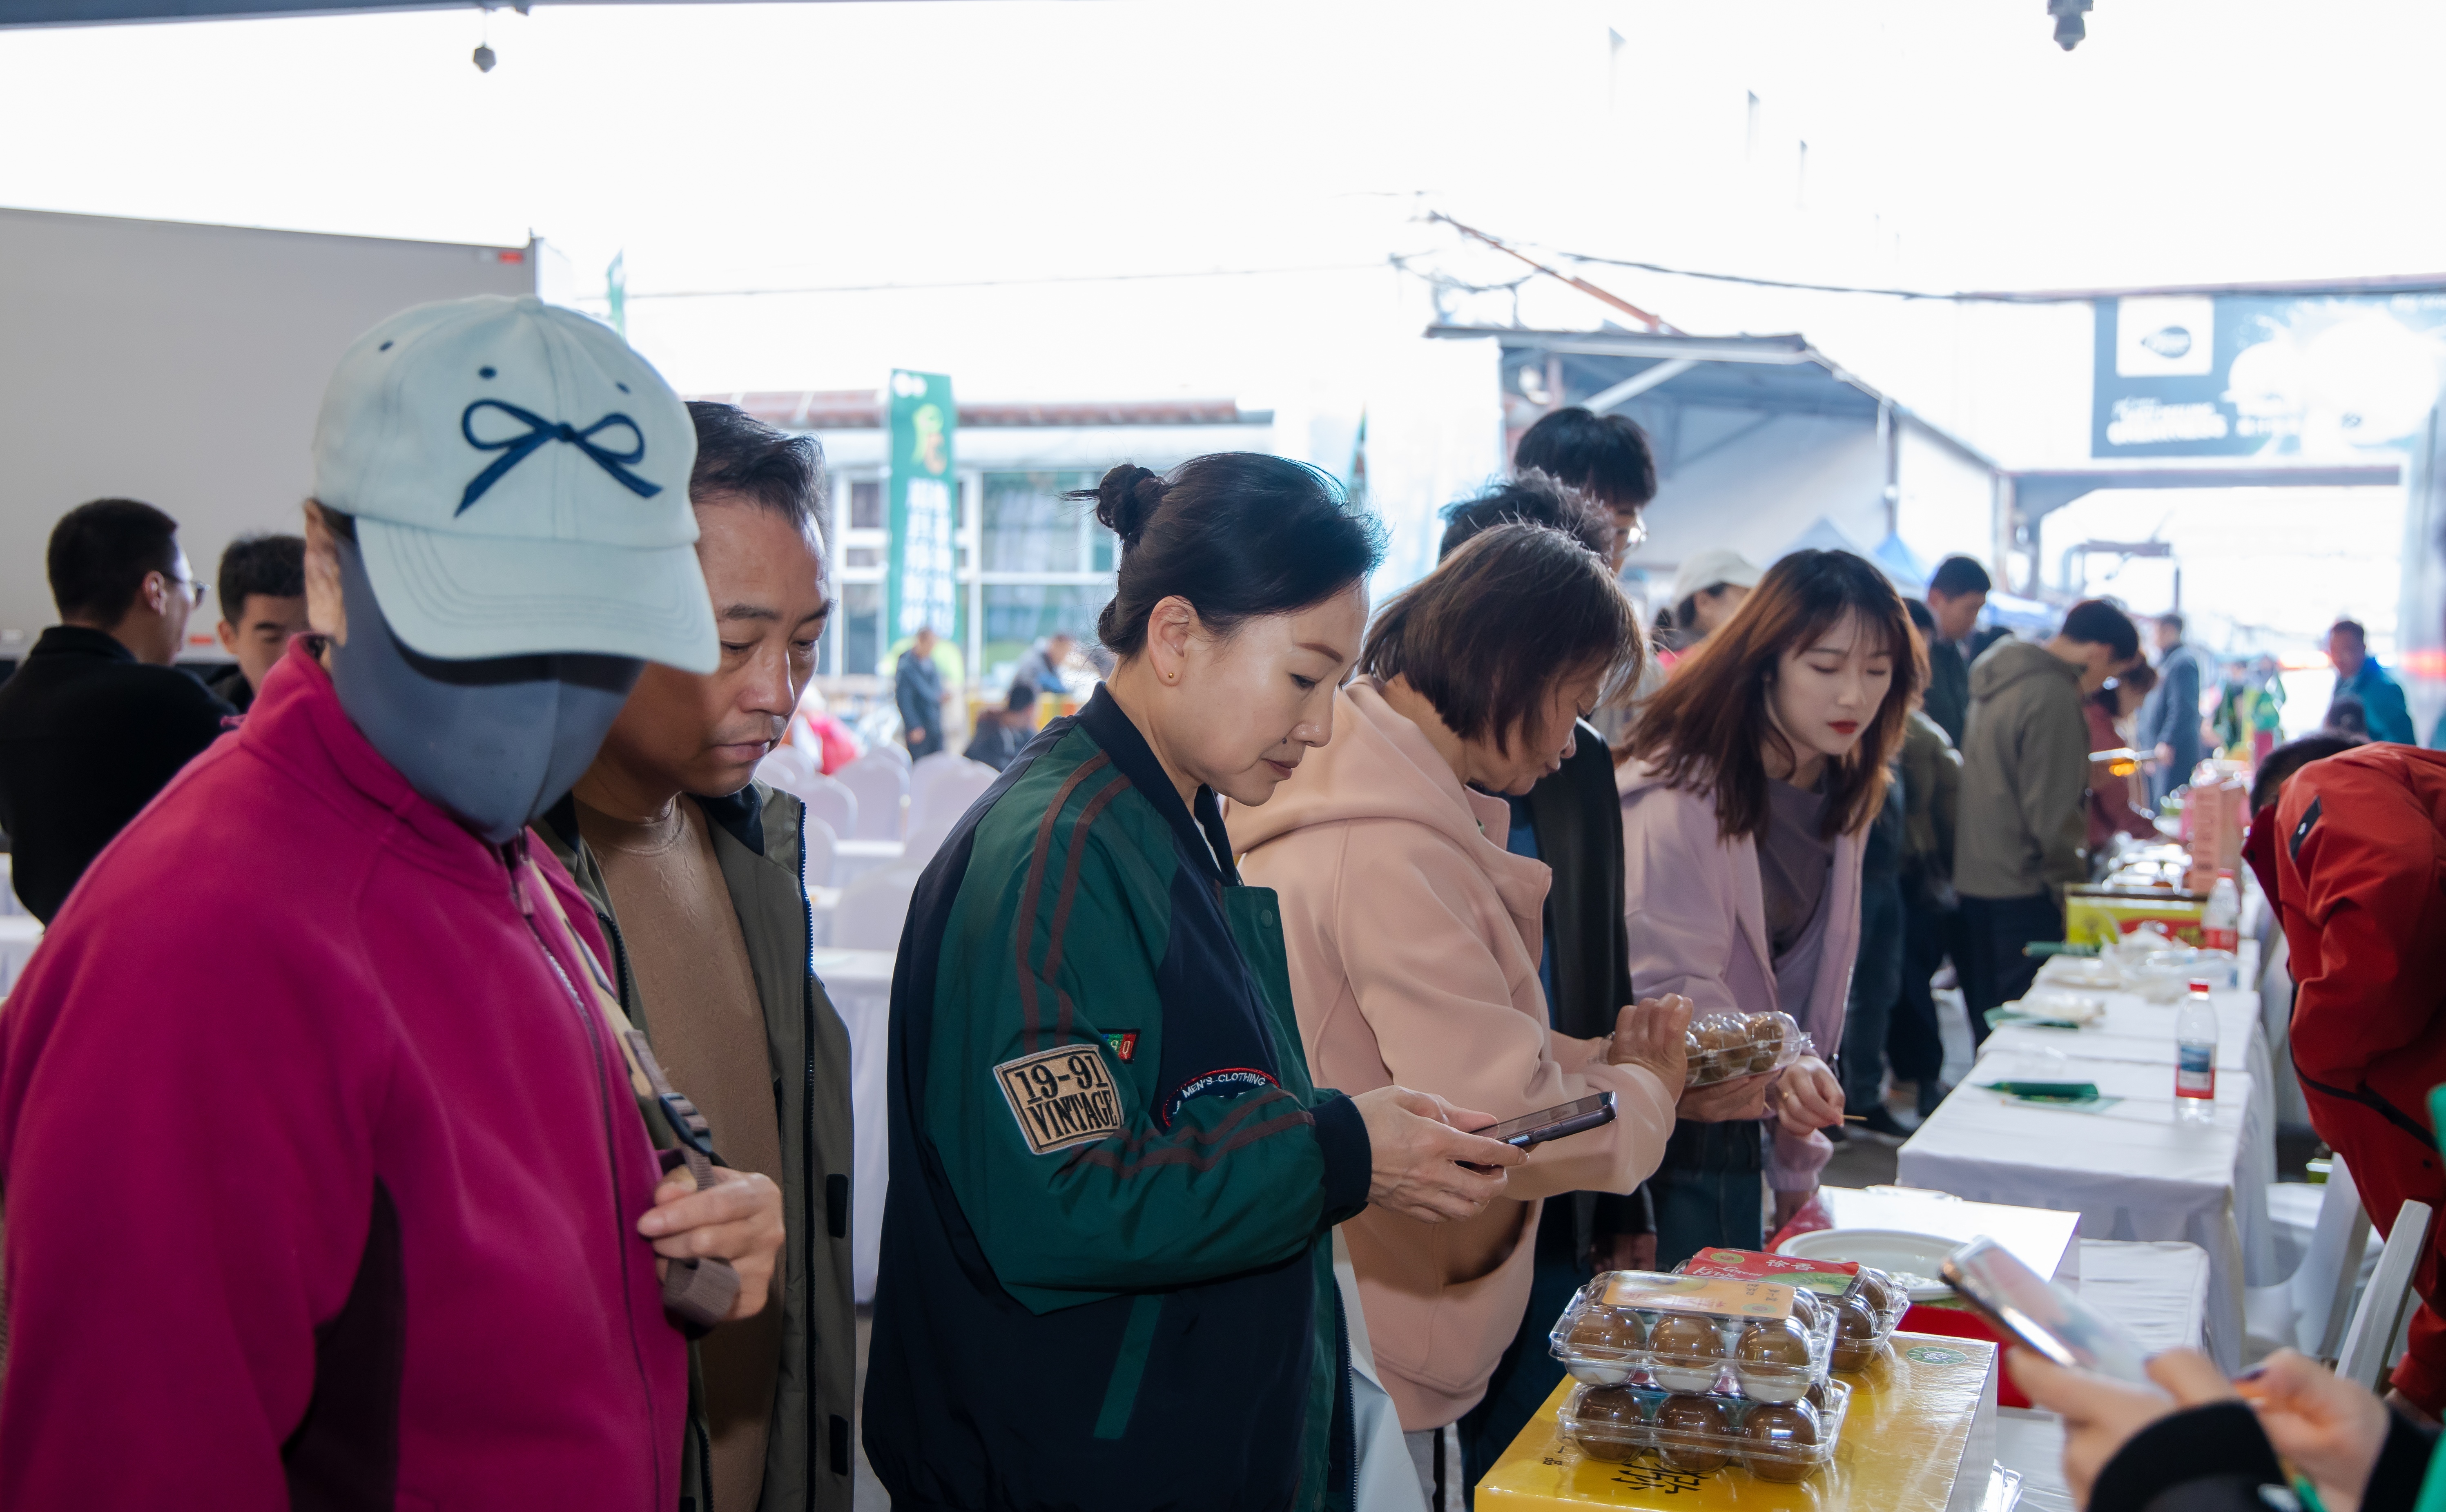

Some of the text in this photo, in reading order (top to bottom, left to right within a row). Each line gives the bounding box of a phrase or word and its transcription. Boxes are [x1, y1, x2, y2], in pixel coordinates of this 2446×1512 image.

[1015, 1055, 1108, 1104] 19-91
[1182, 1073, 1265, 1098] MEN'S CLOTHING
[1026, 1090, 1118, 1140] VINTAGE
[1766, 1260, 1815, 1271] 徐香
